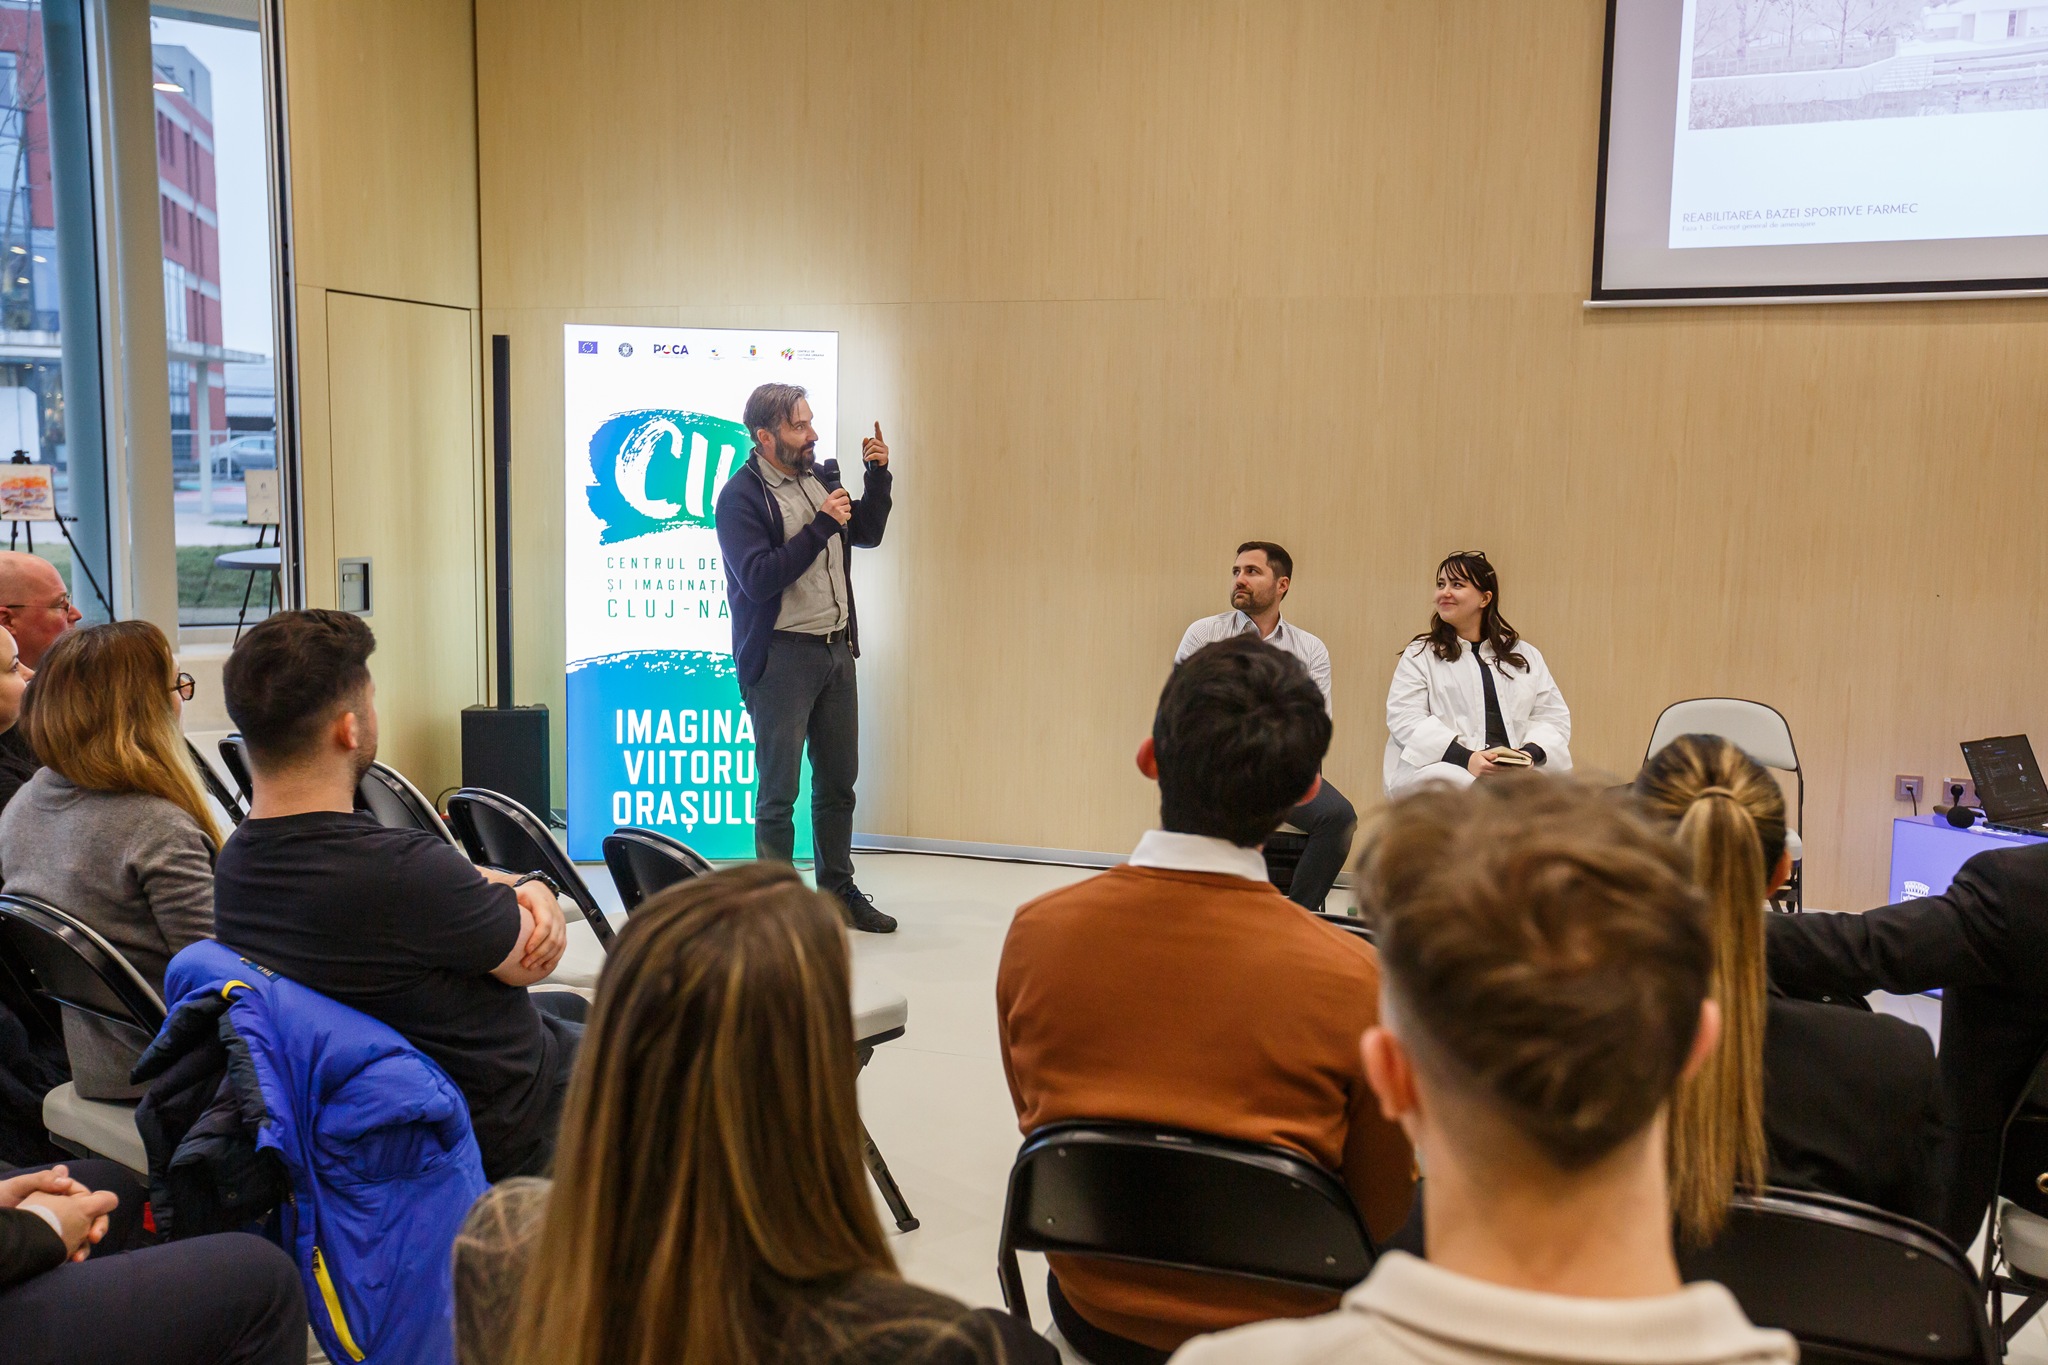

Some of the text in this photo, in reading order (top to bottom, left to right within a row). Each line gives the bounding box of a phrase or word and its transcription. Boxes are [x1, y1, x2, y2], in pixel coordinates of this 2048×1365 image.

[1683, 203, 1919, 222] REABILITAREA BAZEI SPORTIVE FARMEC
[1743, 222, 1768, 231] general
[653, 343, 689, 356] POCA
[607, 557, 717, 570] CENTRUL DE
[607, 599, 729, 619] CLUJ-NA
